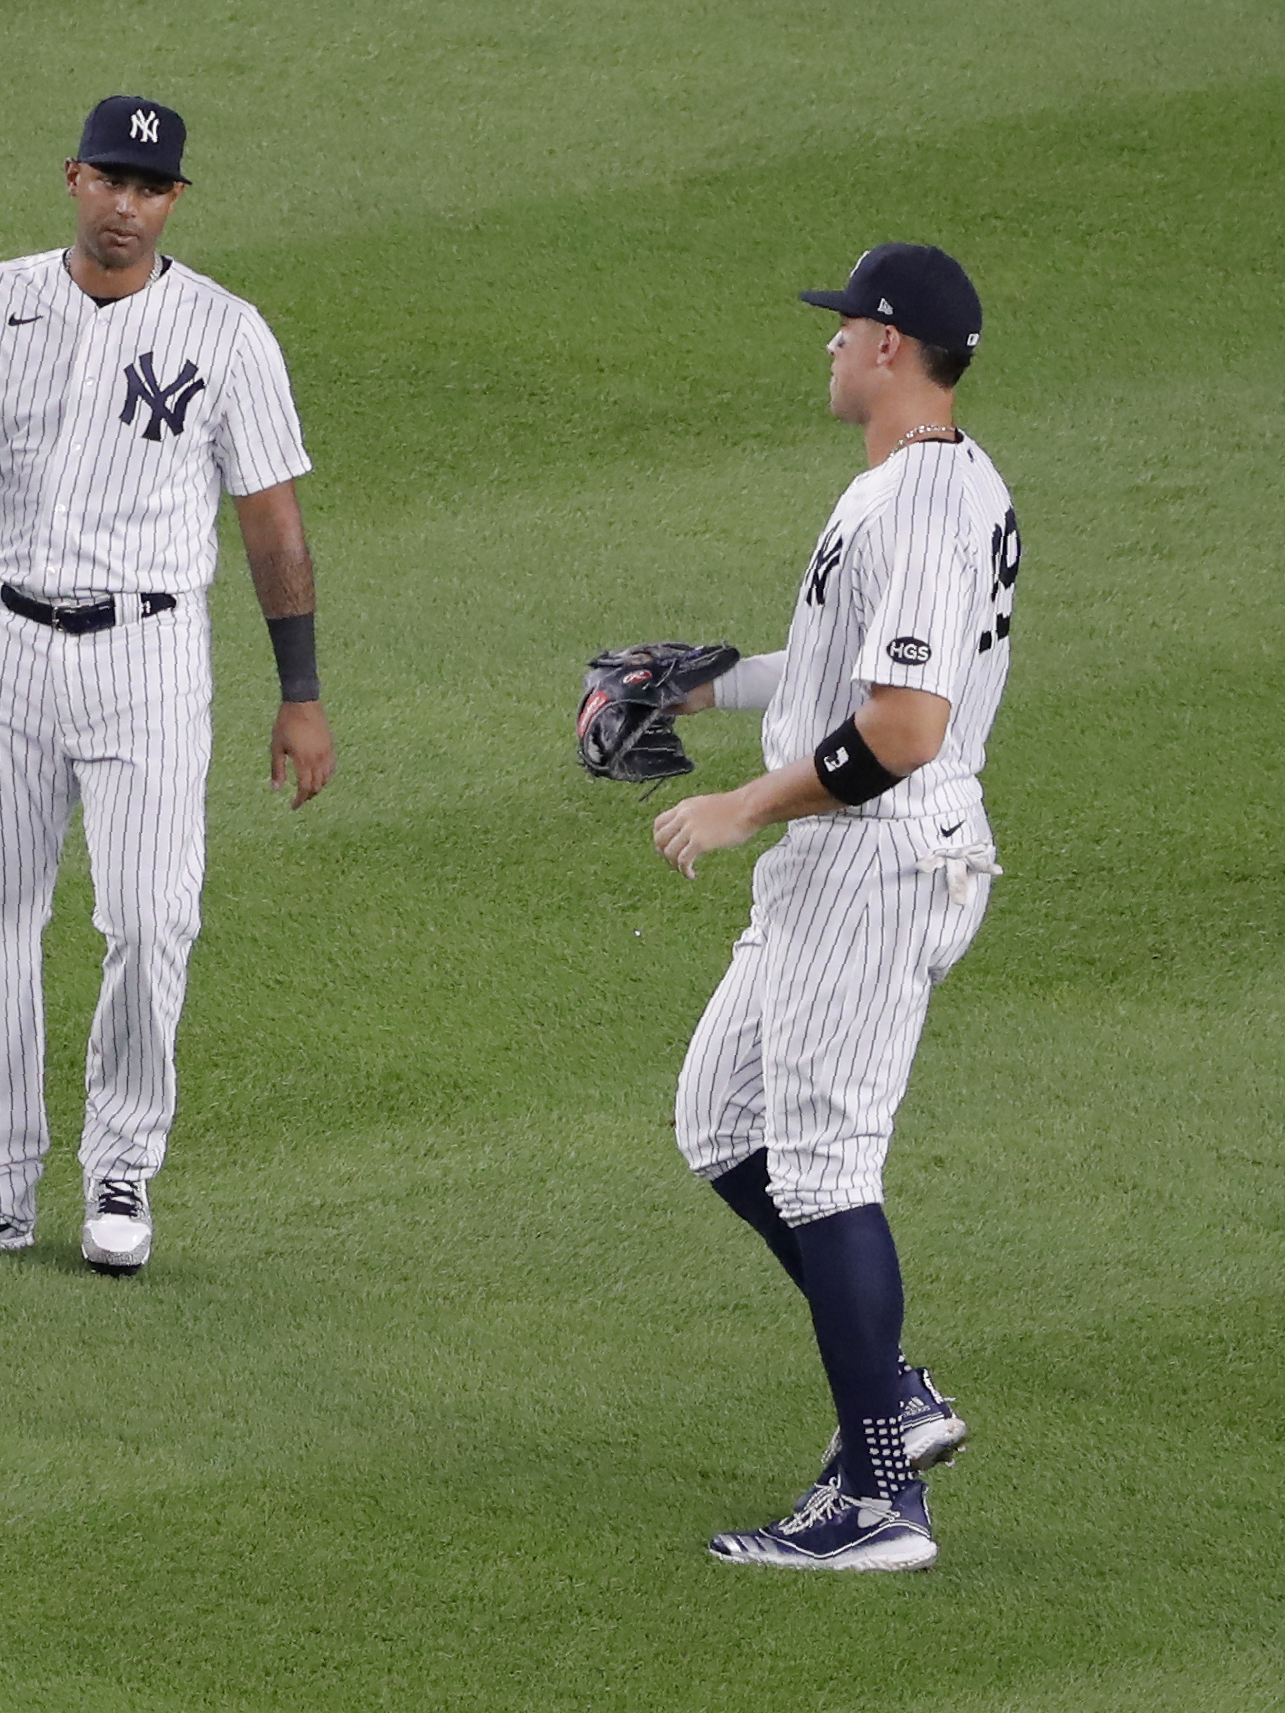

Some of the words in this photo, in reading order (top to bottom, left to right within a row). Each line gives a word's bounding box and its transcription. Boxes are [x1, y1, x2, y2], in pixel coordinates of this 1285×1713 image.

[129, 108, 160, 143] NY
[118, 351, 206, 442] NY
[889, 641, 929, 661] HGS
